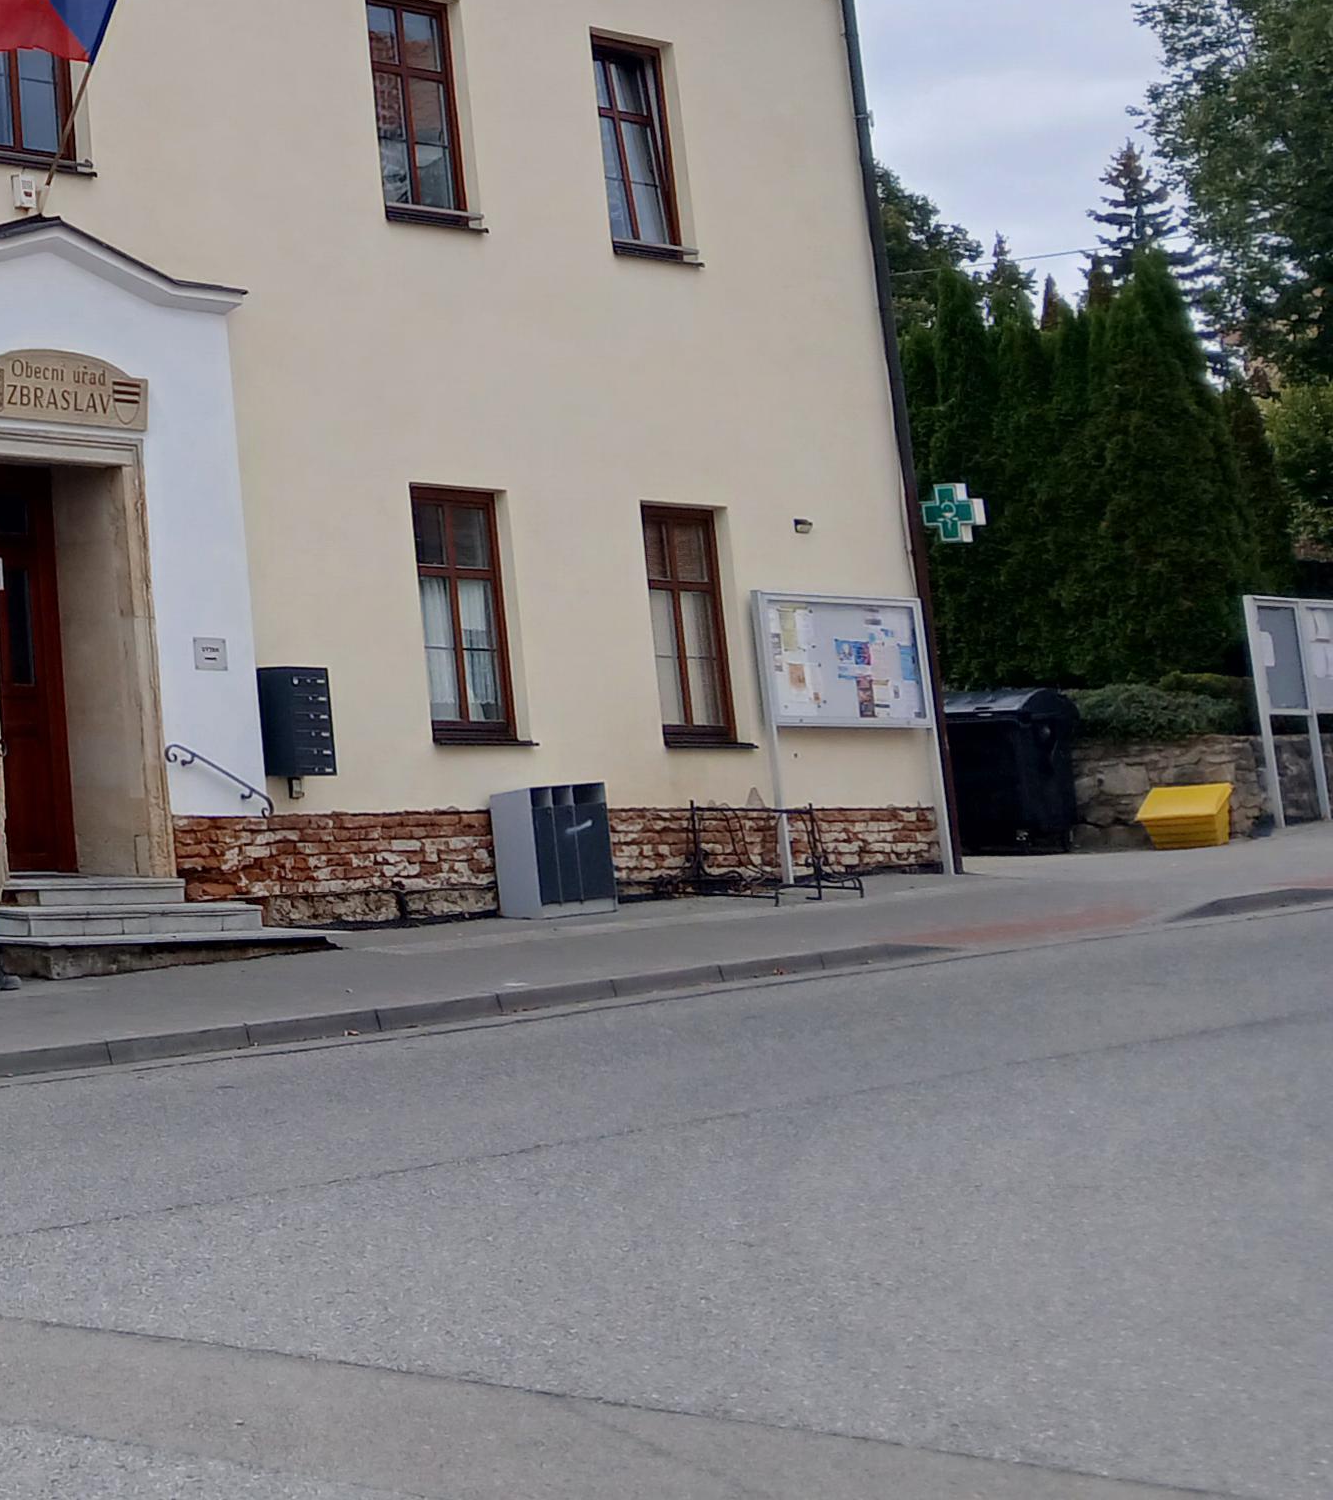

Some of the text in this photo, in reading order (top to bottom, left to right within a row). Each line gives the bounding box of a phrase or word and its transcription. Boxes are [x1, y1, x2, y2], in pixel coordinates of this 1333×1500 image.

[11, 359, 106, 386] Obecní úřad
[6, 384, 111, 414] ZBRASLAV
